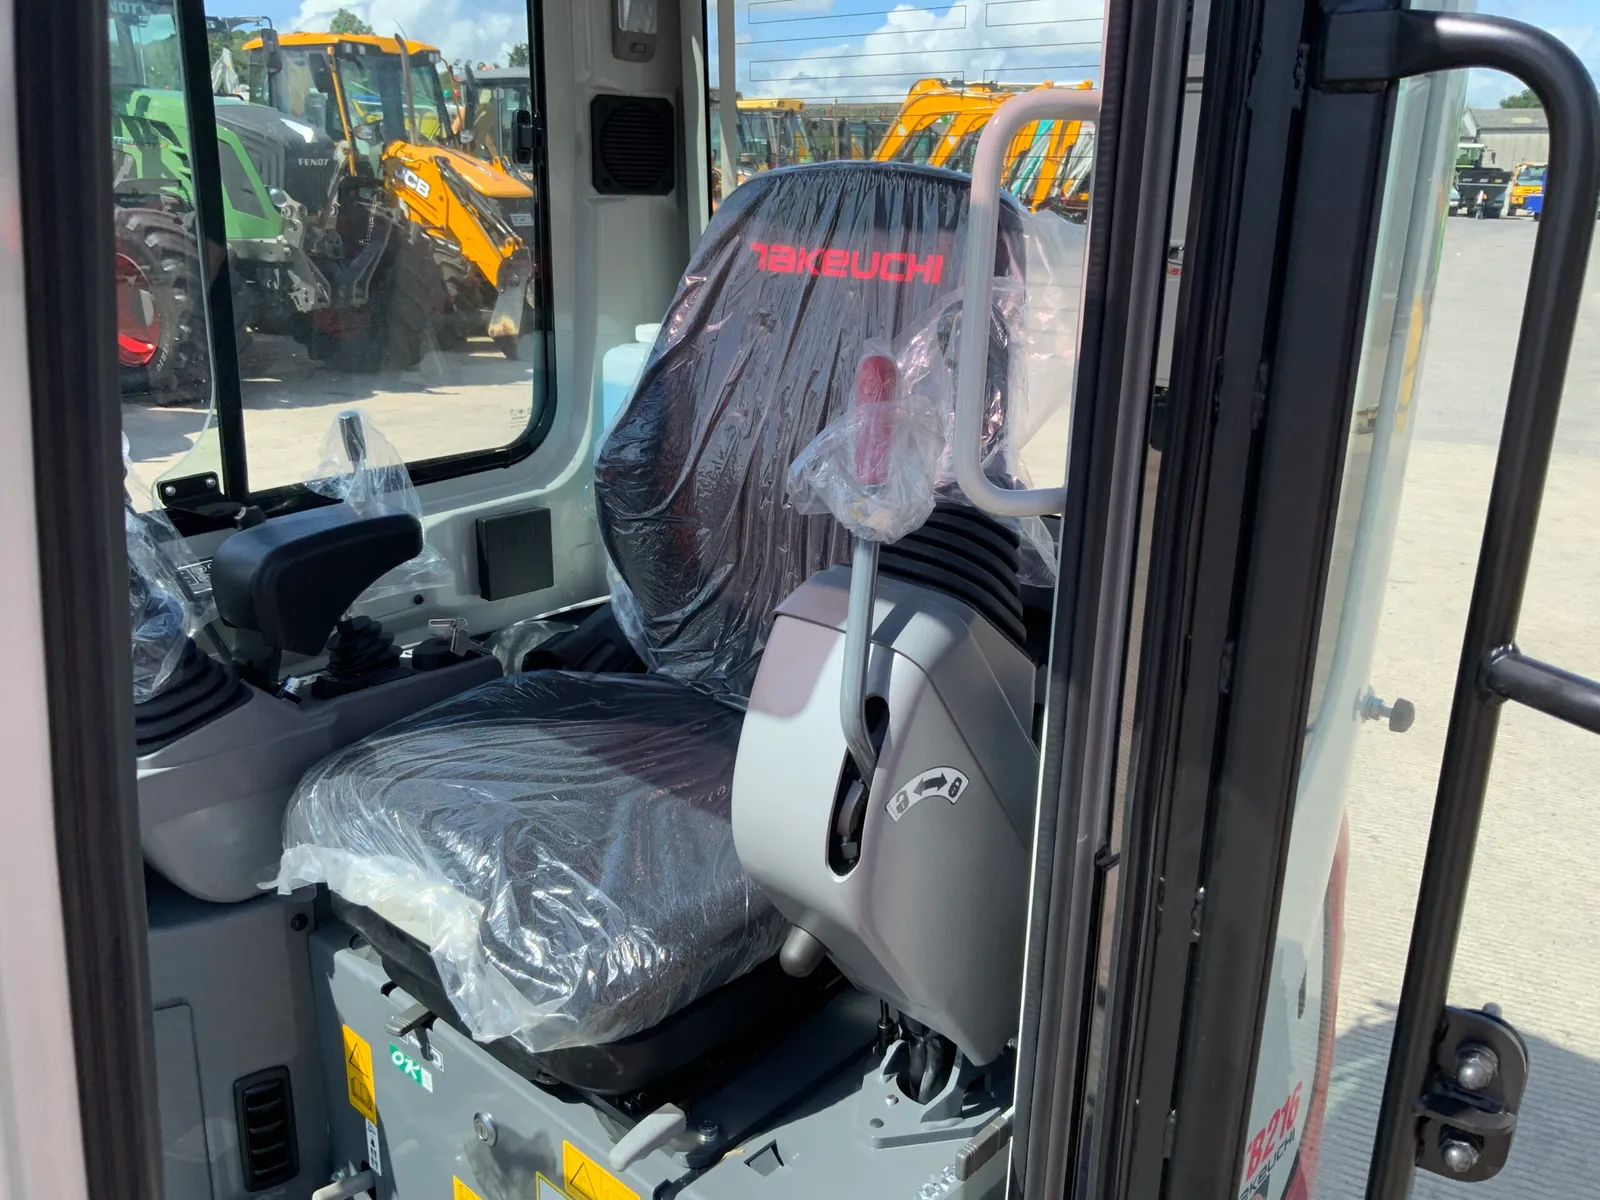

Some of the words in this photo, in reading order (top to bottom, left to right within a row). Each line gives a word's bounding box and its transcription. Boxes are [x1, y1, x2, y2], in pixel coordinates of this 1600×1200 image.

[109, 2, 140, 15] NDT
[297, 158, 330, 167] FENDT
[394, 166, 431, 199] JCB
[750, 243, 944, 285] TAKEUCHI
[391, 1050, 420, 1080] OK
[1239, 1128, 1296, 1200] AKEUCHI
